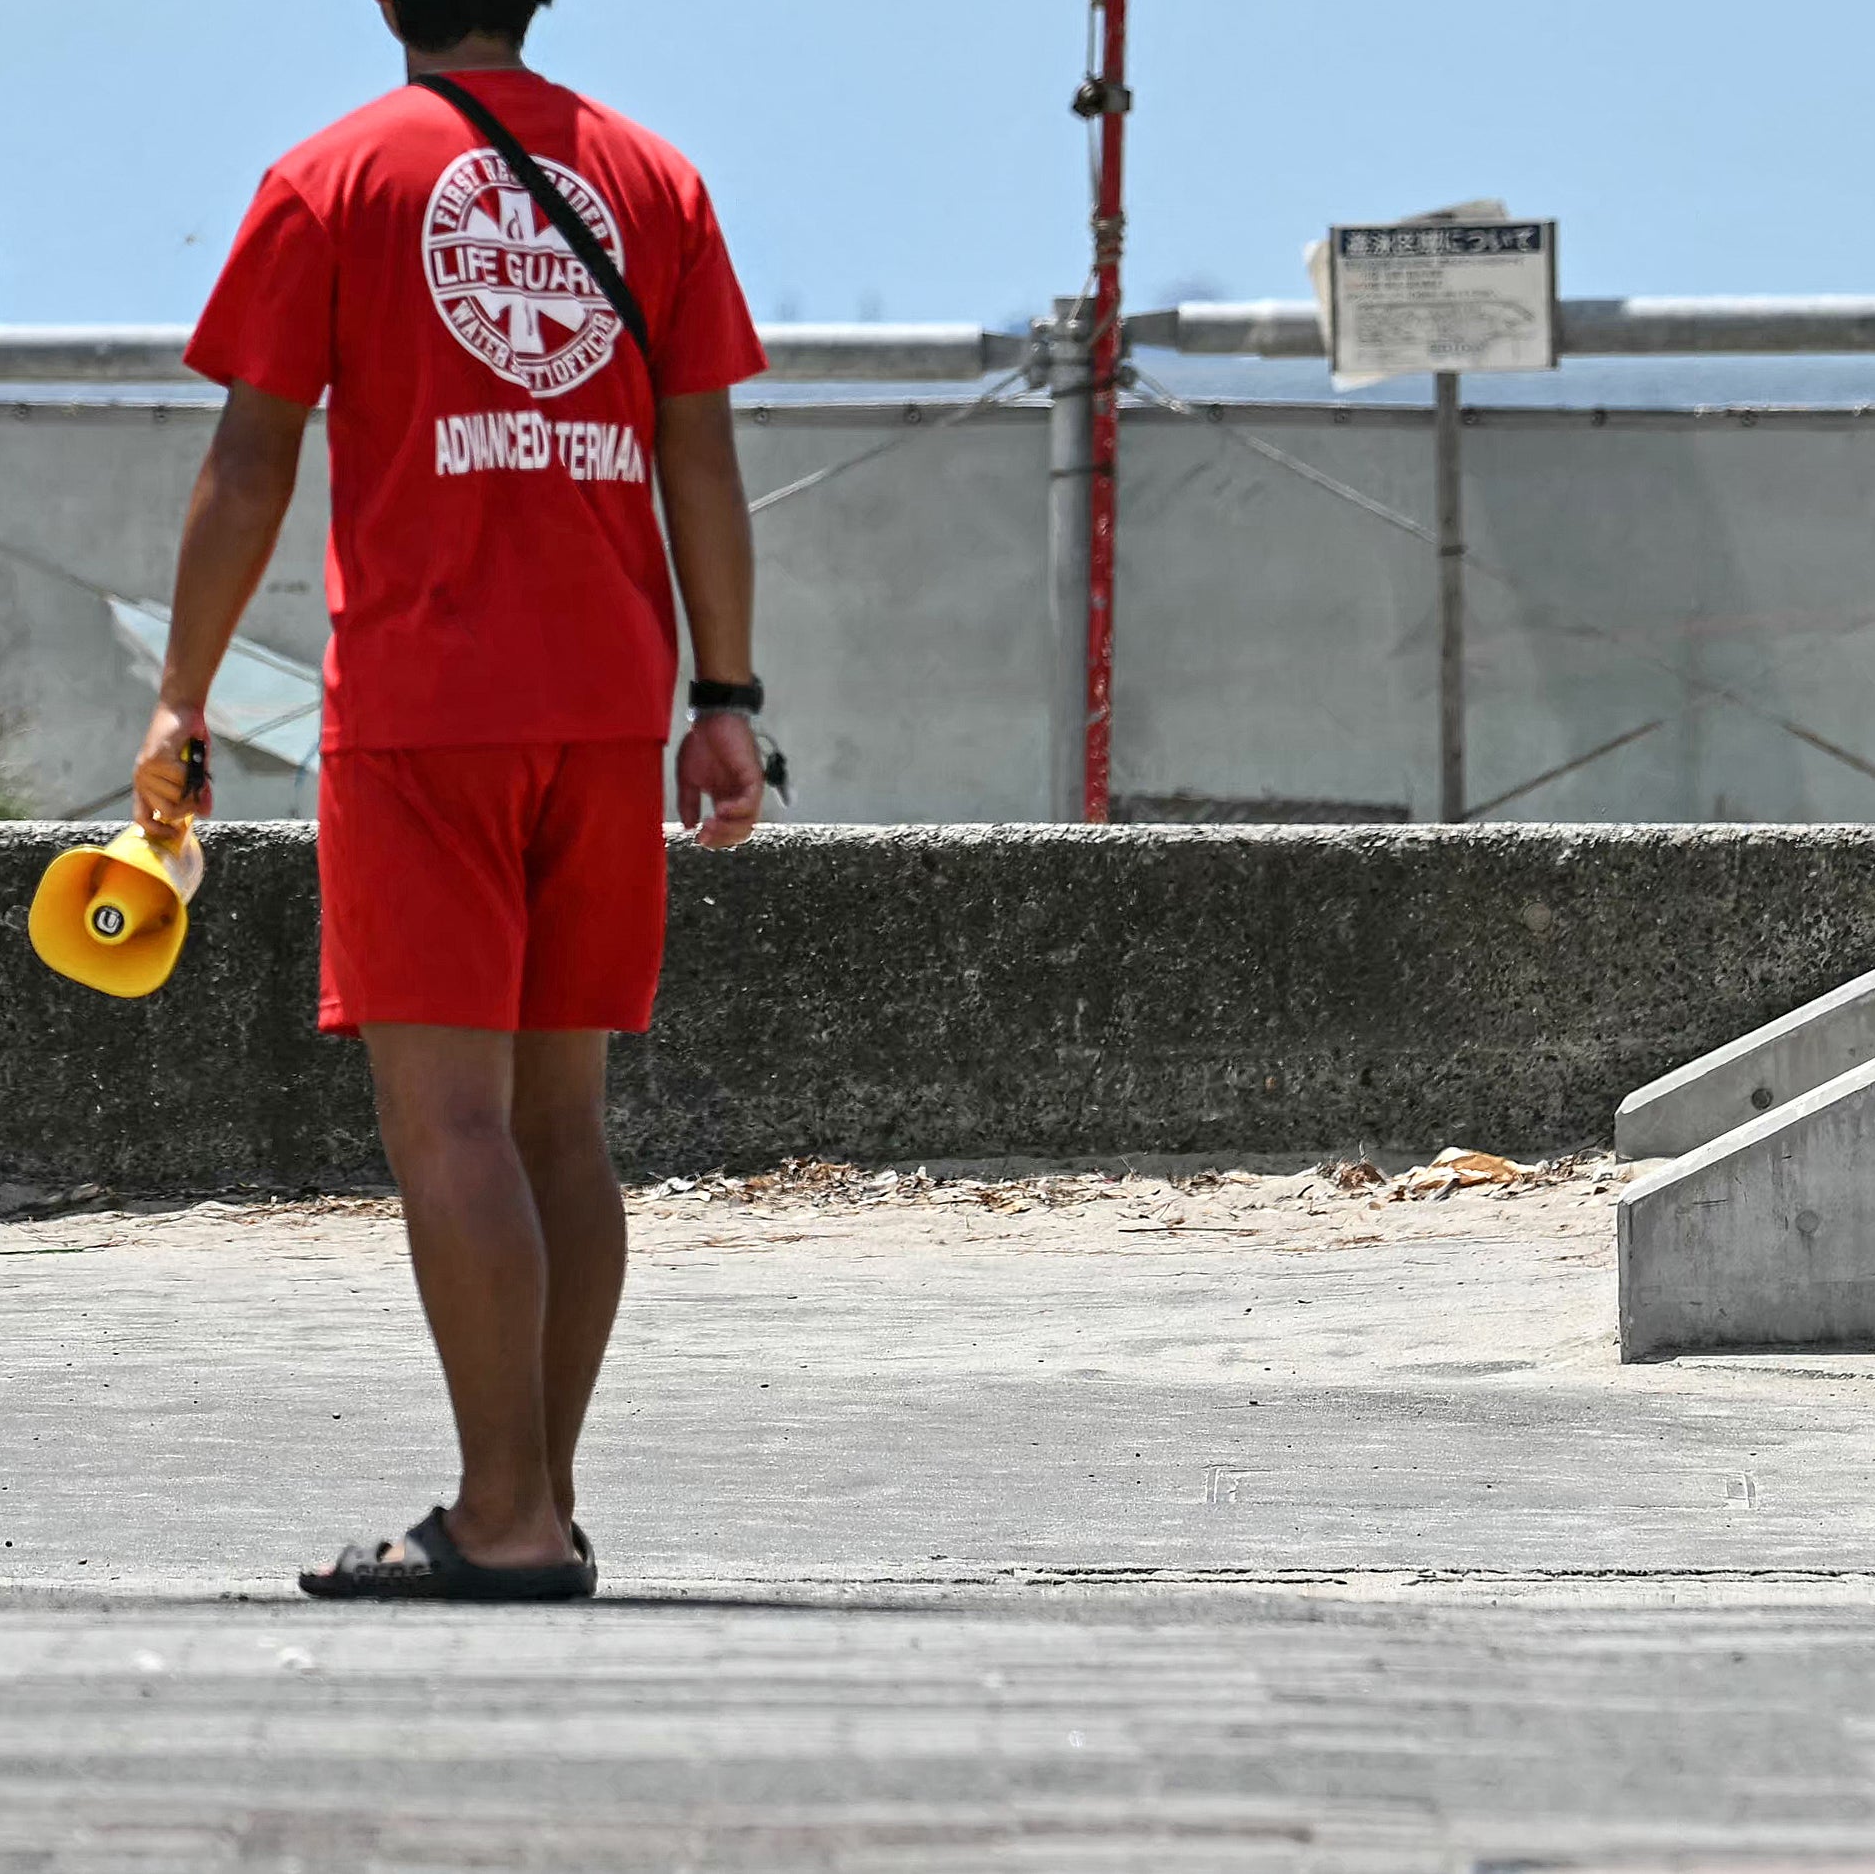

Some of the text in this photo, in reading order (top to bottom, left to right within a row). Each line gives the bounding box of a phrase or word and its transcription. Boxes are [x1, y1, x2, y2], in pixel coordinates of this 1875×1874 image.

[434, 163, 481, 228] FIRST
[433, 246, 604, 295] LIFE GUAR
[450, 299, 511, 369] WATER
[435, 410, 551, 475] ADVANCED
